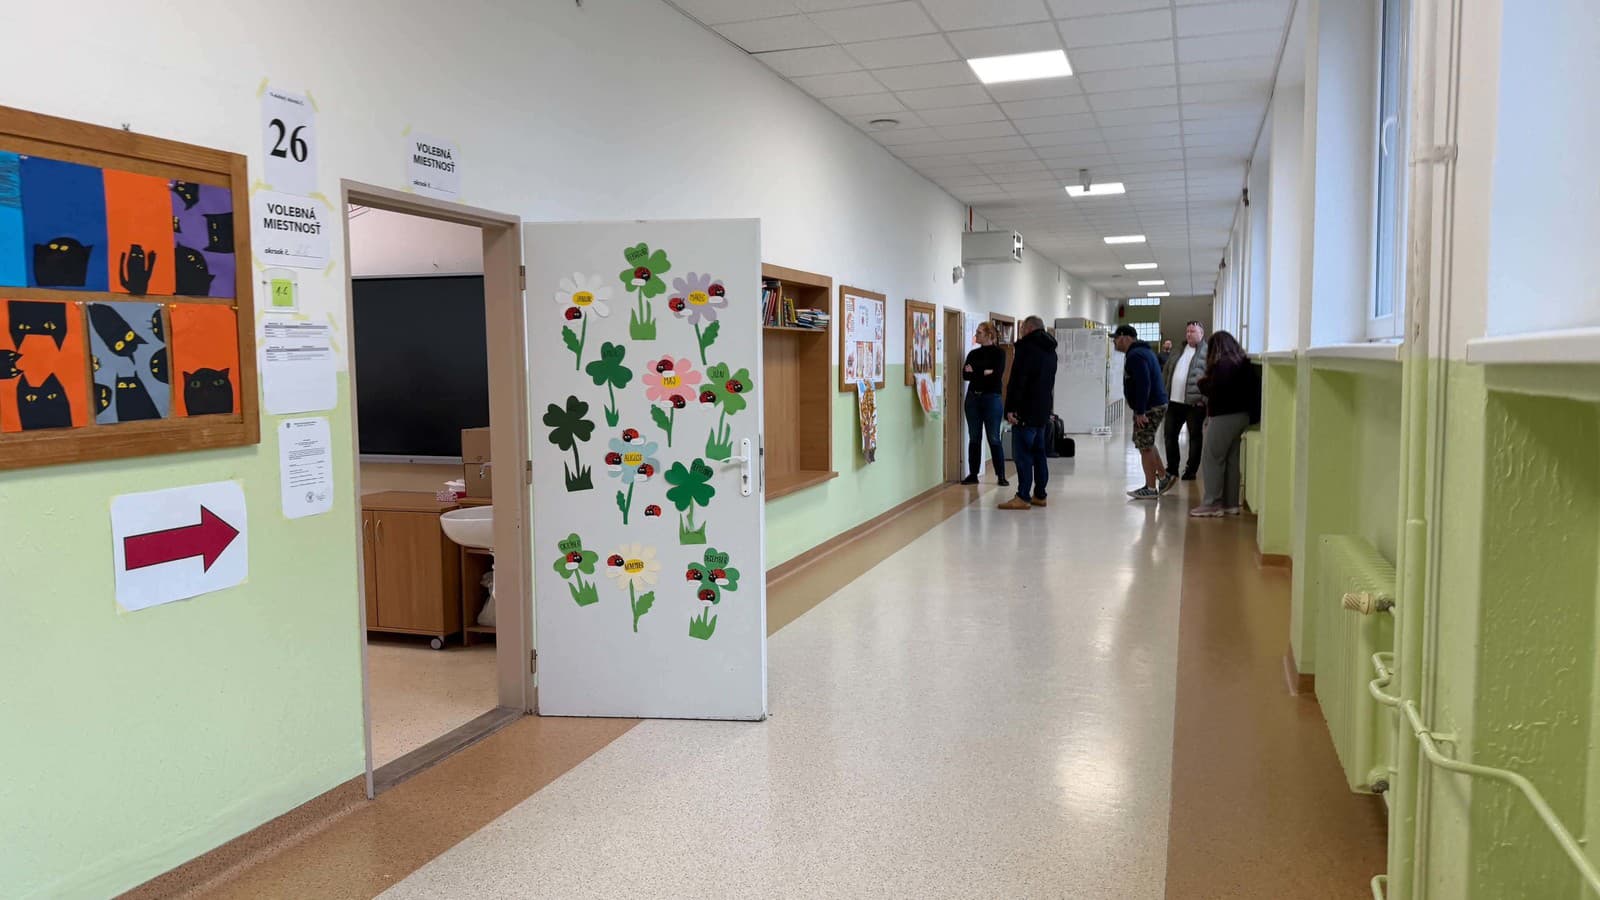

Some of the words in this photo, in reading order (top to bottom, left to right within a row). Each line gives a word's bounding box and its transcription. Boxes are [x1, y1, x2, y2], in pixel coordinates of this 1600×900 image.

[269, 118, 308, 163] 26
[416, 142, 452, 160] VOLEBNÁ
[413, 154, 455, 174] MIESTNOSŤ
[267, 202, 317, 220] VOLEBNÁ
[263, 217, 321, 235] MIESTNOSŤ
